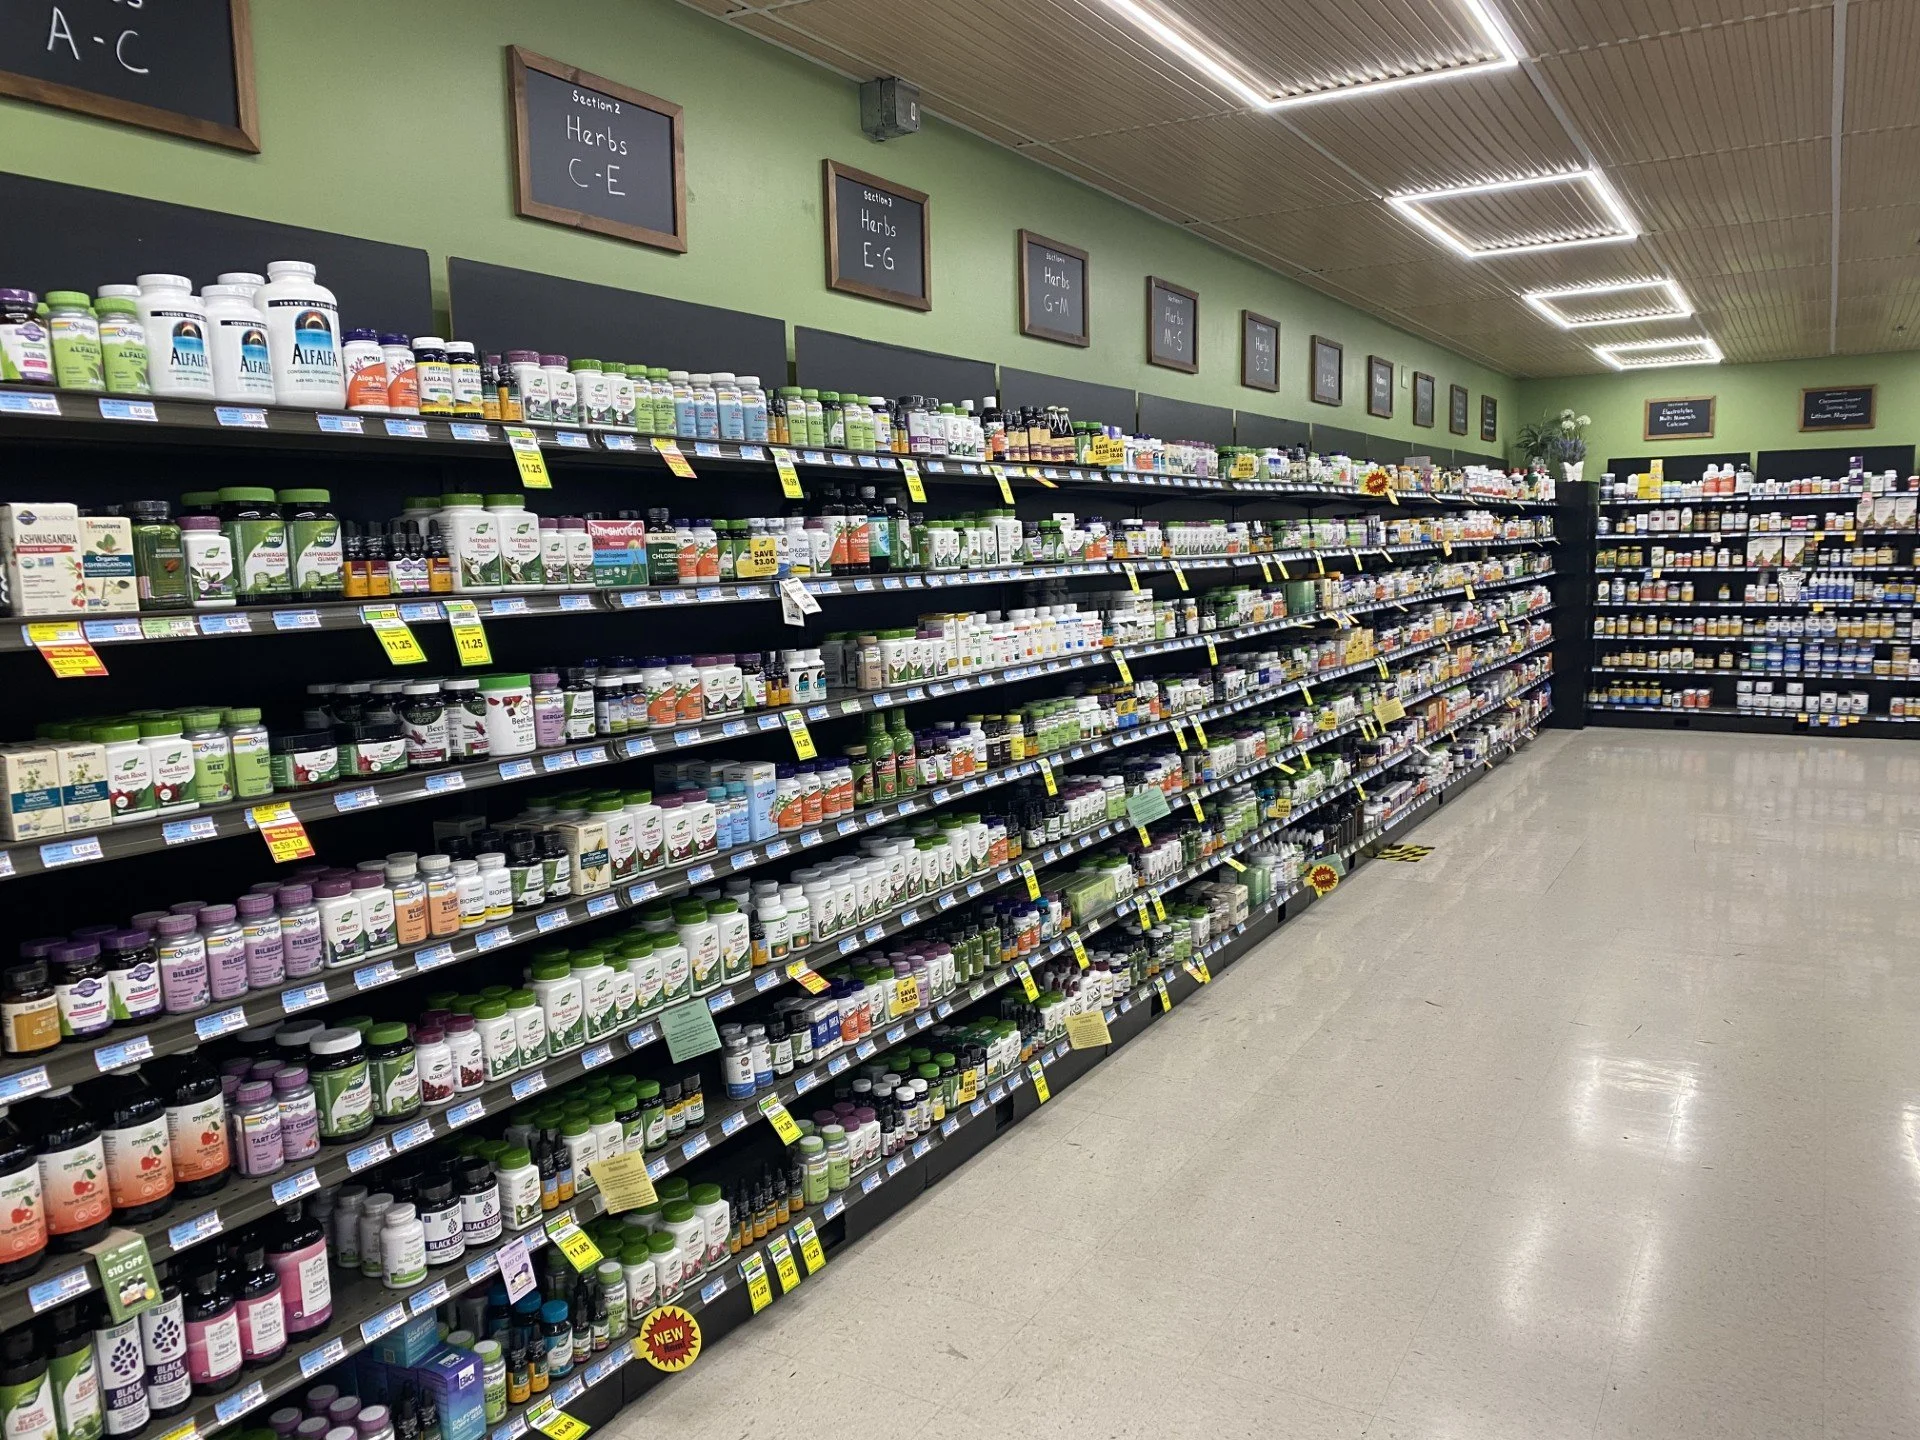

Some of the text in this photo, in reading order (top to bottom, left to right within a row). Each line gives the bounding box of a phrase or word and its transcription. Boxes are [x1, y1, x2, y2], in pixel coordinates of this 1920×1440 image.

[566, 114, 628, 156] Herbs
[861, 208, 896, 238] Herbs
[863, 242, 894, 271] E-G
[1044, 266, 1070, 290] Herbs
[1165, 306, 1184, 326] Herbs
[171, 348, 209, 367] ALFALFA
[292, 344, 338, 366] ALFALFA
[522, 463, 542, 474] 11.25
[1369, 478, 1384, 488] NEW
[19, 533, 78, 545] ASHWAGANDHA
[754, 550, 774, 558] SAVE
[754, 558, 775, 566] $3.00
[386, 640, 413, 651] 11.25
[460, 638, 484, 649] 11.25
[511, 717, 526, 725] Beet
[426, 724, 444, 733] Beet
[256, 756, 270, 765] BEET
[159, 766, 174, 774] Beet
[207, 762, 224, 771] BEET
[114, 773, 130, 781] Beet
[280, 839, 303, 850] $9.19
[1315, 873, 1331, 882] NEW
[369, 913, 391, 923] Bilberry
[336, 923, 359, 933] Bilberry
[130, 983, 156, 993] Bilberry
[900, 988, 915, 998] SAVE
[900, 993, 918, 1004] $3.00
[73, 1000, 103, 1010] Bilberry
[394, 1079, 409, 1087] TART
[251, 1137, 267, 1145] TART
[80, 1189, 103, 1201] Cherry
[465, 1221, 487, 1231] BLACK
[429, 1241, 451, 1250] BLACK
[569, 1243, 591, 1259] 11.85
[806, 1248, 820, 1263] 11.25
[107, 1256, 144, 1277] $10 OFF
[780, 1267, 794, 1280] 11.25
[312, 1278, 327, 1287] Black
[309, 1285, 323, 1294] Seed
[752, 1284, 767, 1300] 11.25
[653, 1326, 684, 1347] NEW
[157, 1360, 182, 1375] BLACK
[153, 1368, 185, 1384] SEED OIL
[116, 1381, 142, 1398] BLACK
[113, 1389, 145, 1408] SEED OIL
[452, 1404, 482, 1425] CALIFORNIA
[553, 1421, 575, 1437] 10.49
